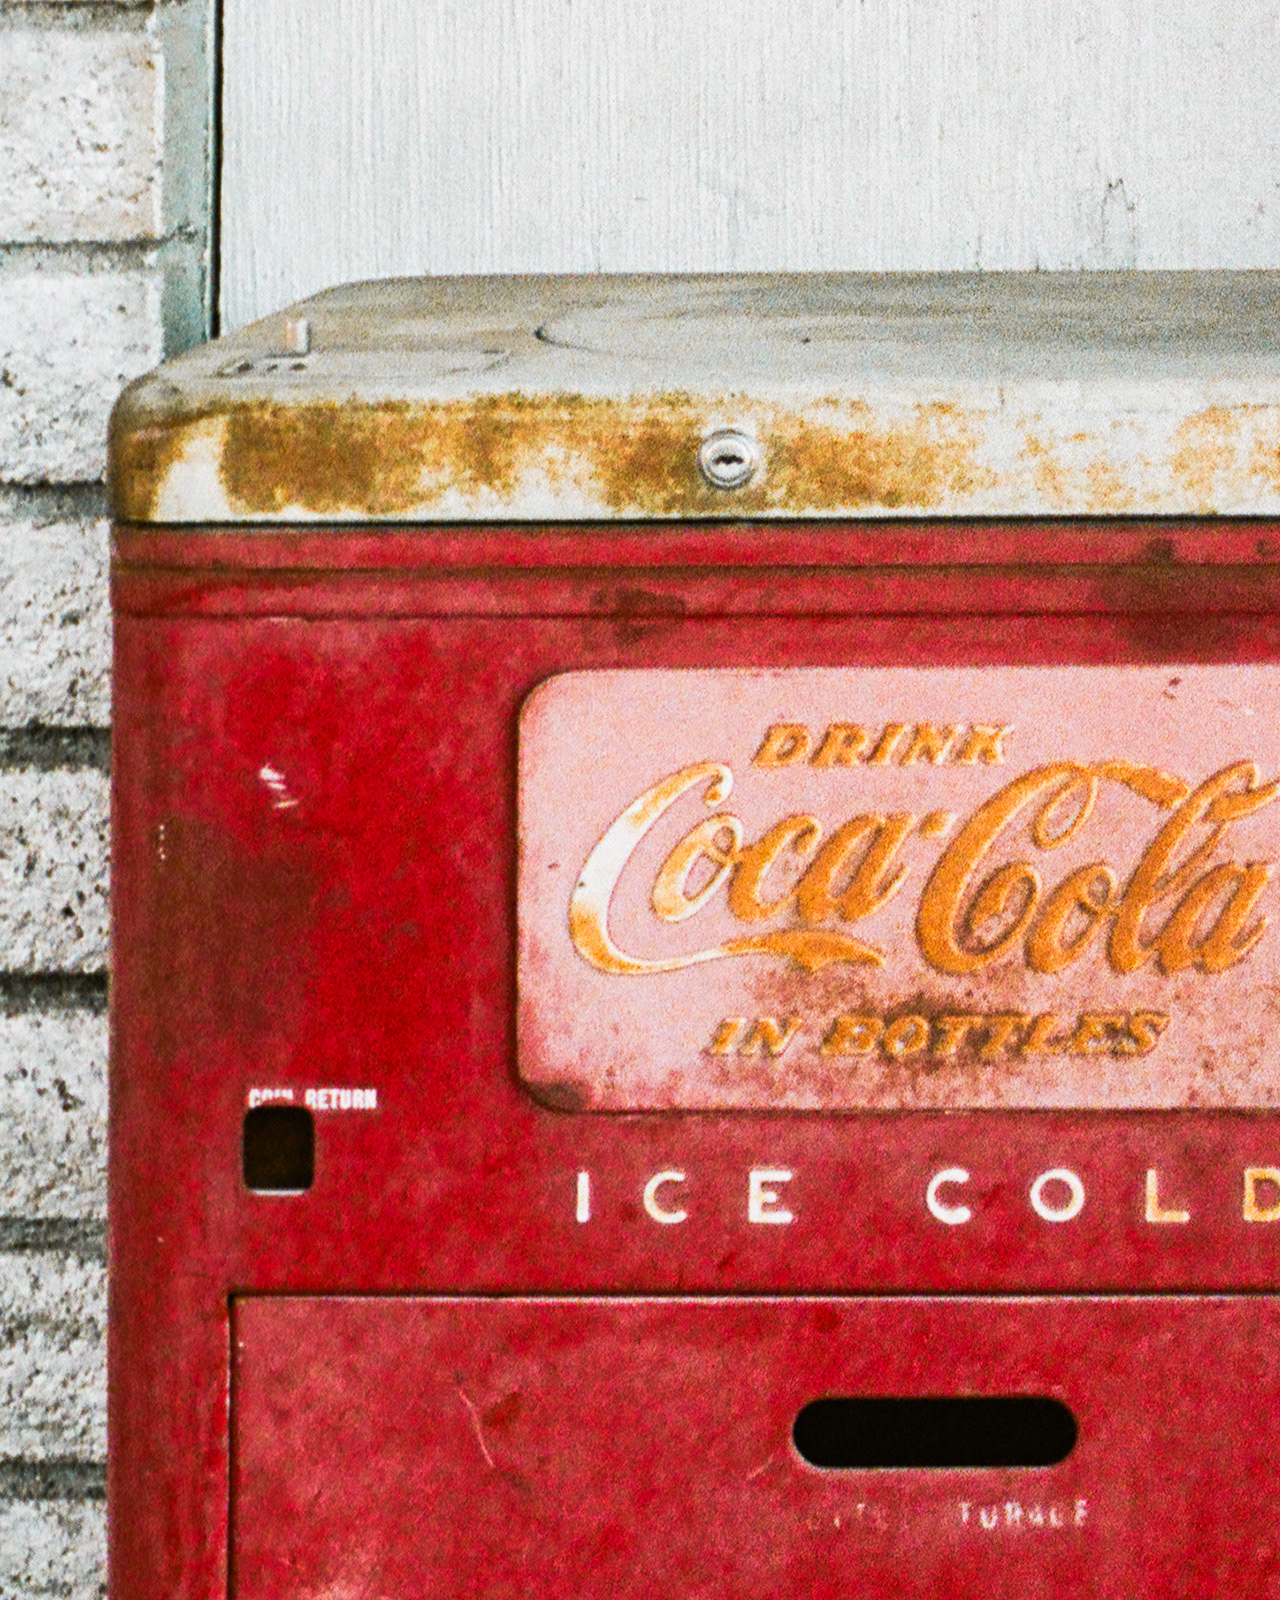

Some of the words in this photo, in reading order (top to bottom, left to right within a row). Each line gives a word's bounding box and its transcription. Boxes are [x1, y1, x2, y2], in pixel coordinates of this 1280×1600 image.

[749, 722, 1014, 767] DRINK
[706, 1015, 801, 1057] IN
[818, 1009, 1171, 1058] BOTTLES
[304, 1088, 378, 1109] RETURN
[575, 1168, 795, 1225] ICE
